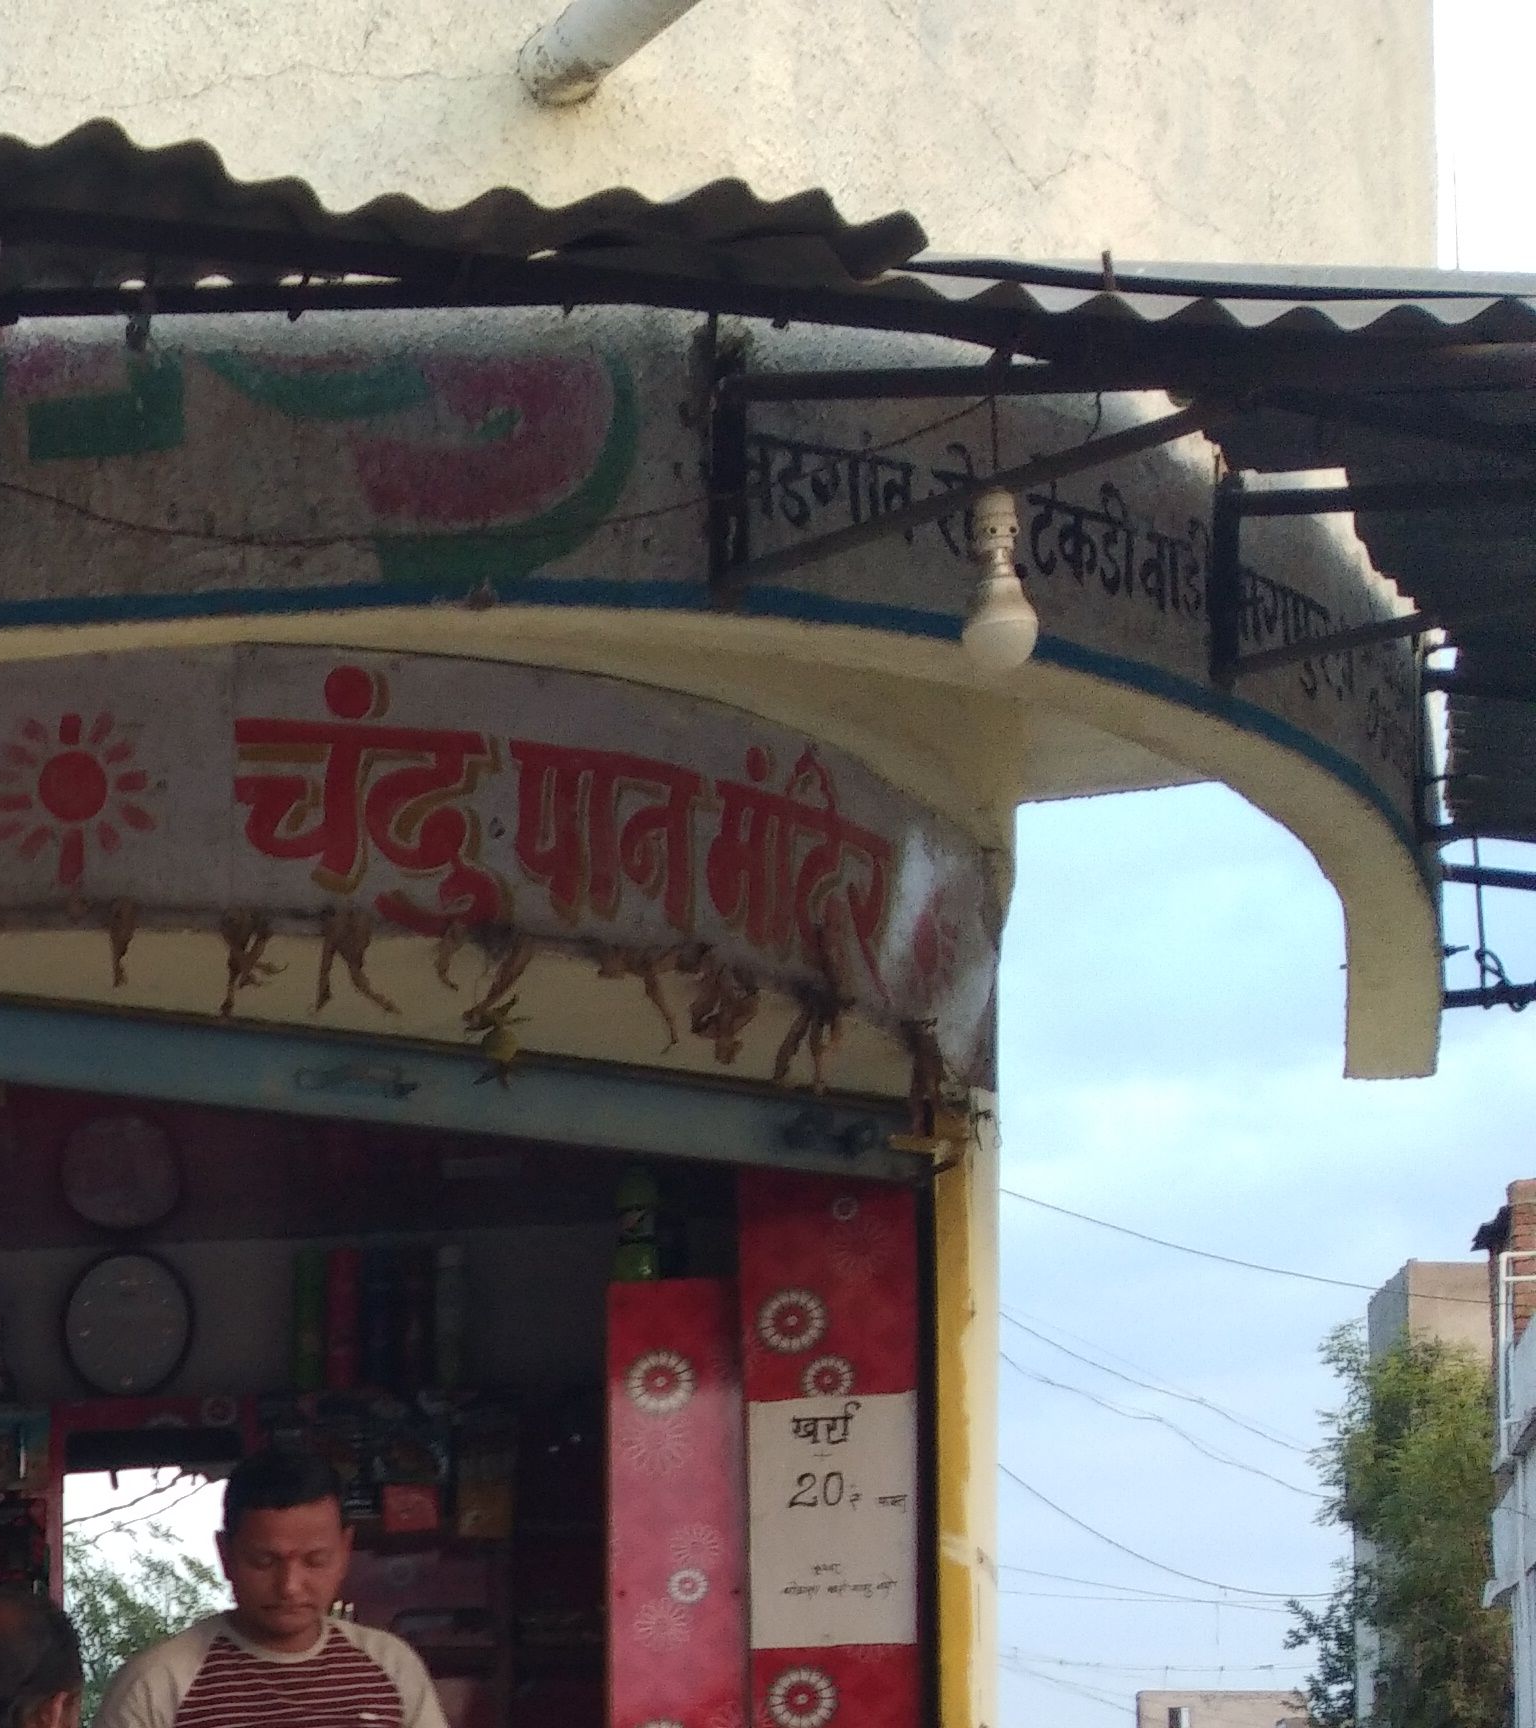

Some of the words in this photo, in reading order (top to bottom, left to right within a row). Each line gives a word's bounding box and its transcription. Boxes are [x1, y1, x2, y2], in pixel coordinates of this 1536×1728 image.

[232, 663, 502, 936] चंदु
[508, 739, 702, 930] पान
[791, 1401, 862, 1446] खर्रा
[788, 1471, 845, 1510] 20
